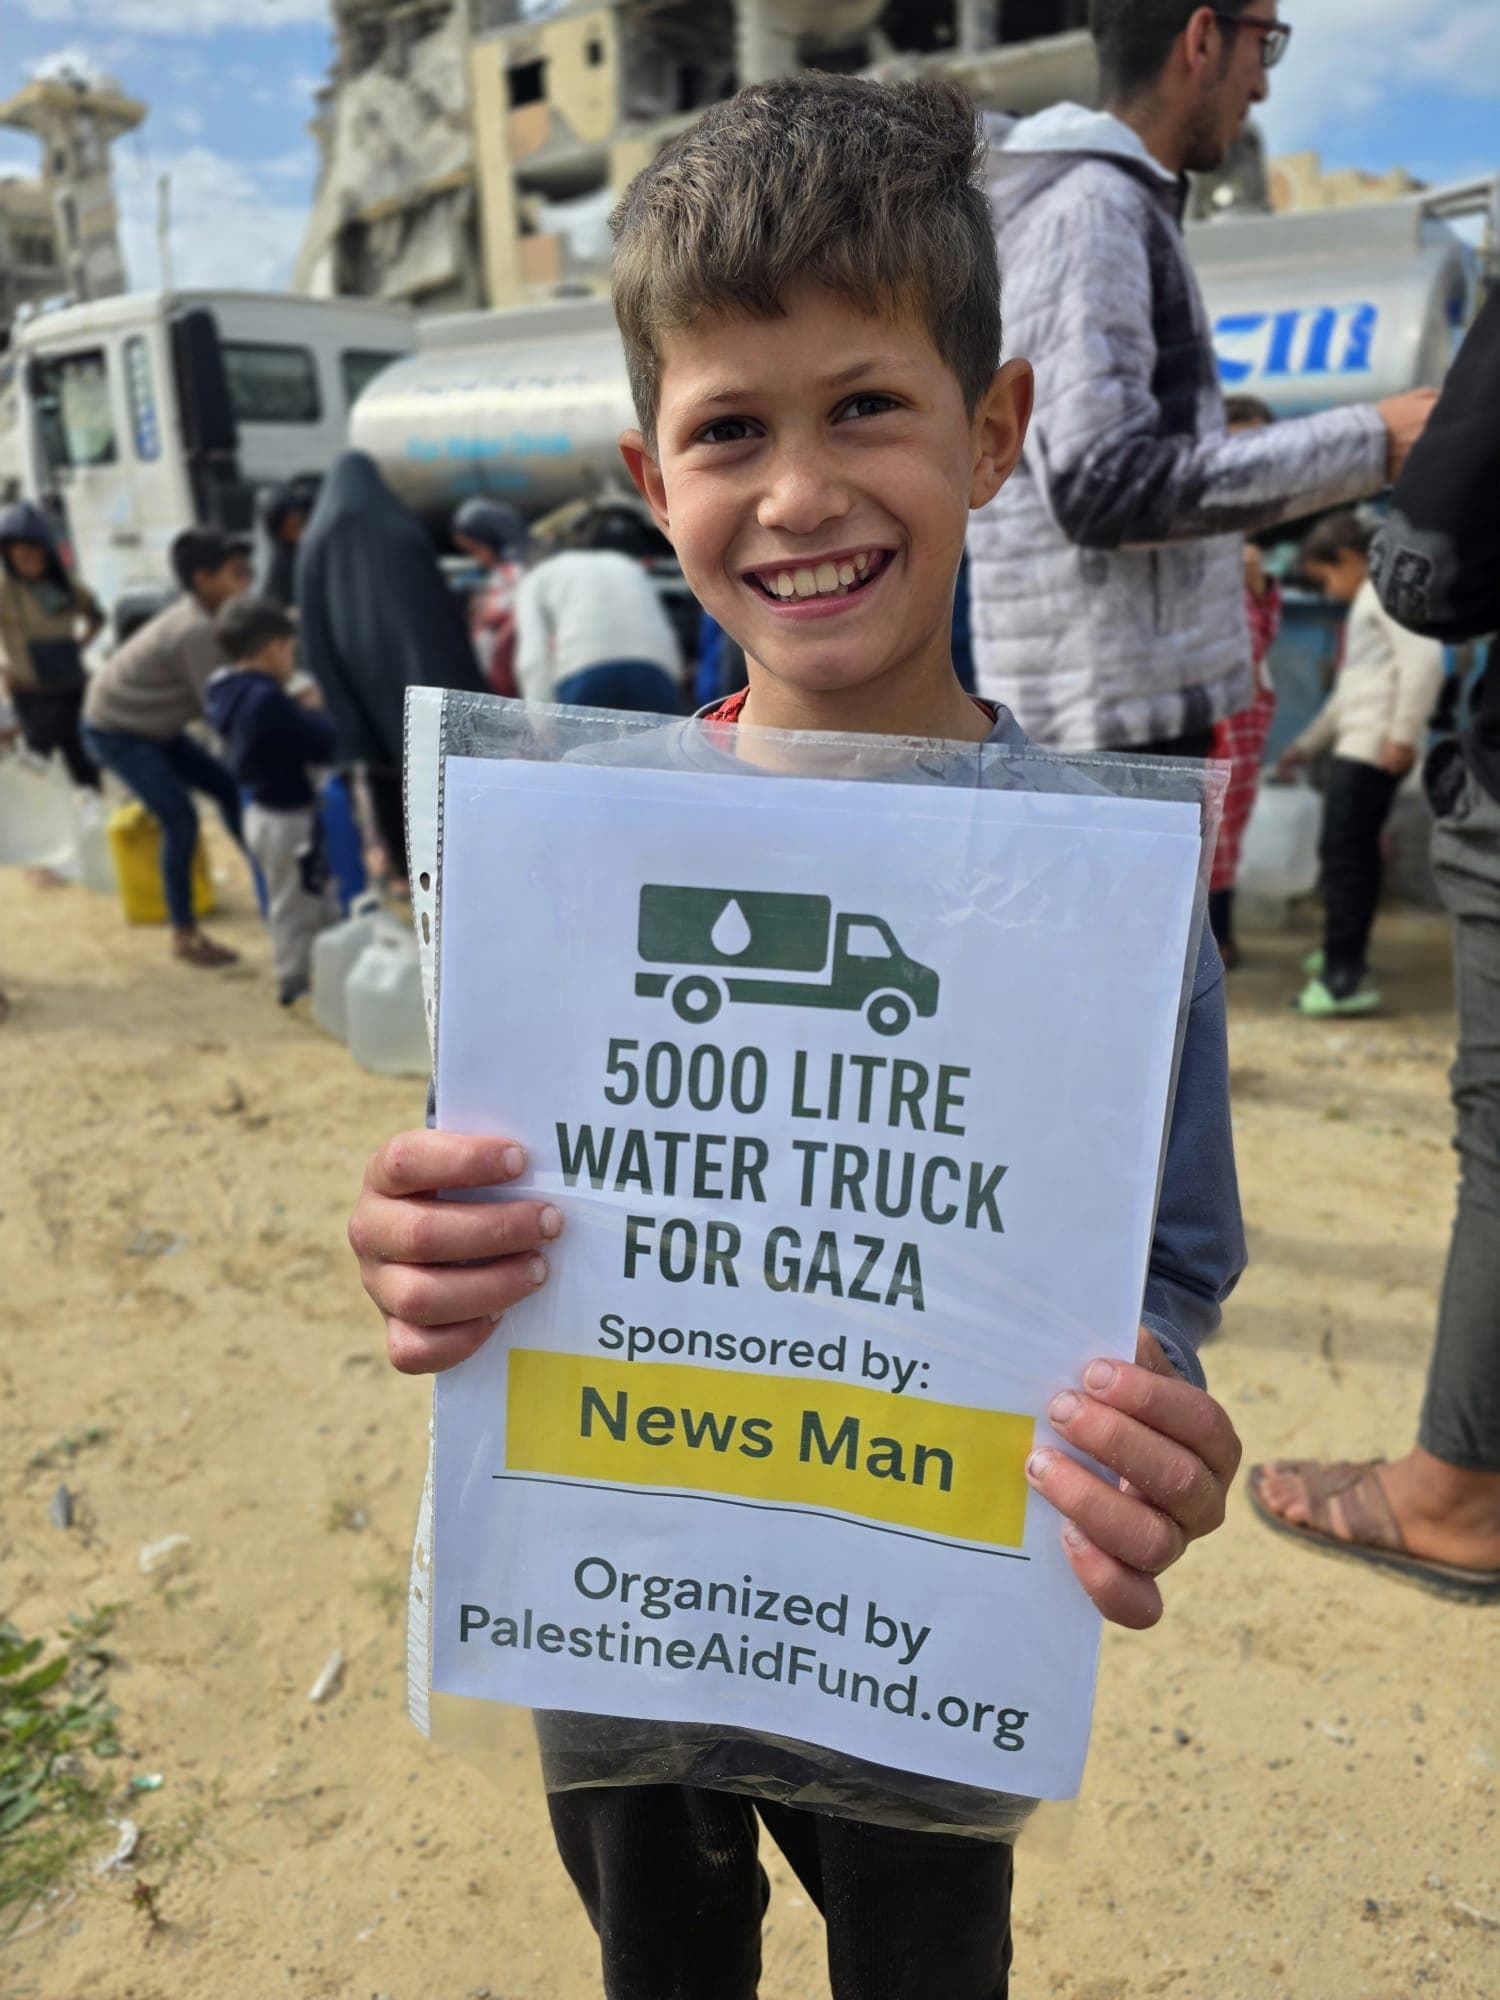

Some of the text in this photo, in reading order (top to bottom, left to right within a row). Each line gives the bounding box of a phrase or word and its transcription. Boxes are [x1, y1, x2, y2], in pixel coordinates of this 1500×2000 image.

[603, 1038, 971, 1136] 5000 LITRE
[555, 1122, 1009, 1233] WATER TRUCK
[623, 1214, 925, 1312] FOR GAZA
[598, 1314, 931, 1394] Sponsored by:
[580, 1386, 955, 1492] News Man
[574, 1557, 931, 1665] Organized by
[459, 1604, 1030, 1752] PalestineAidFund.org
